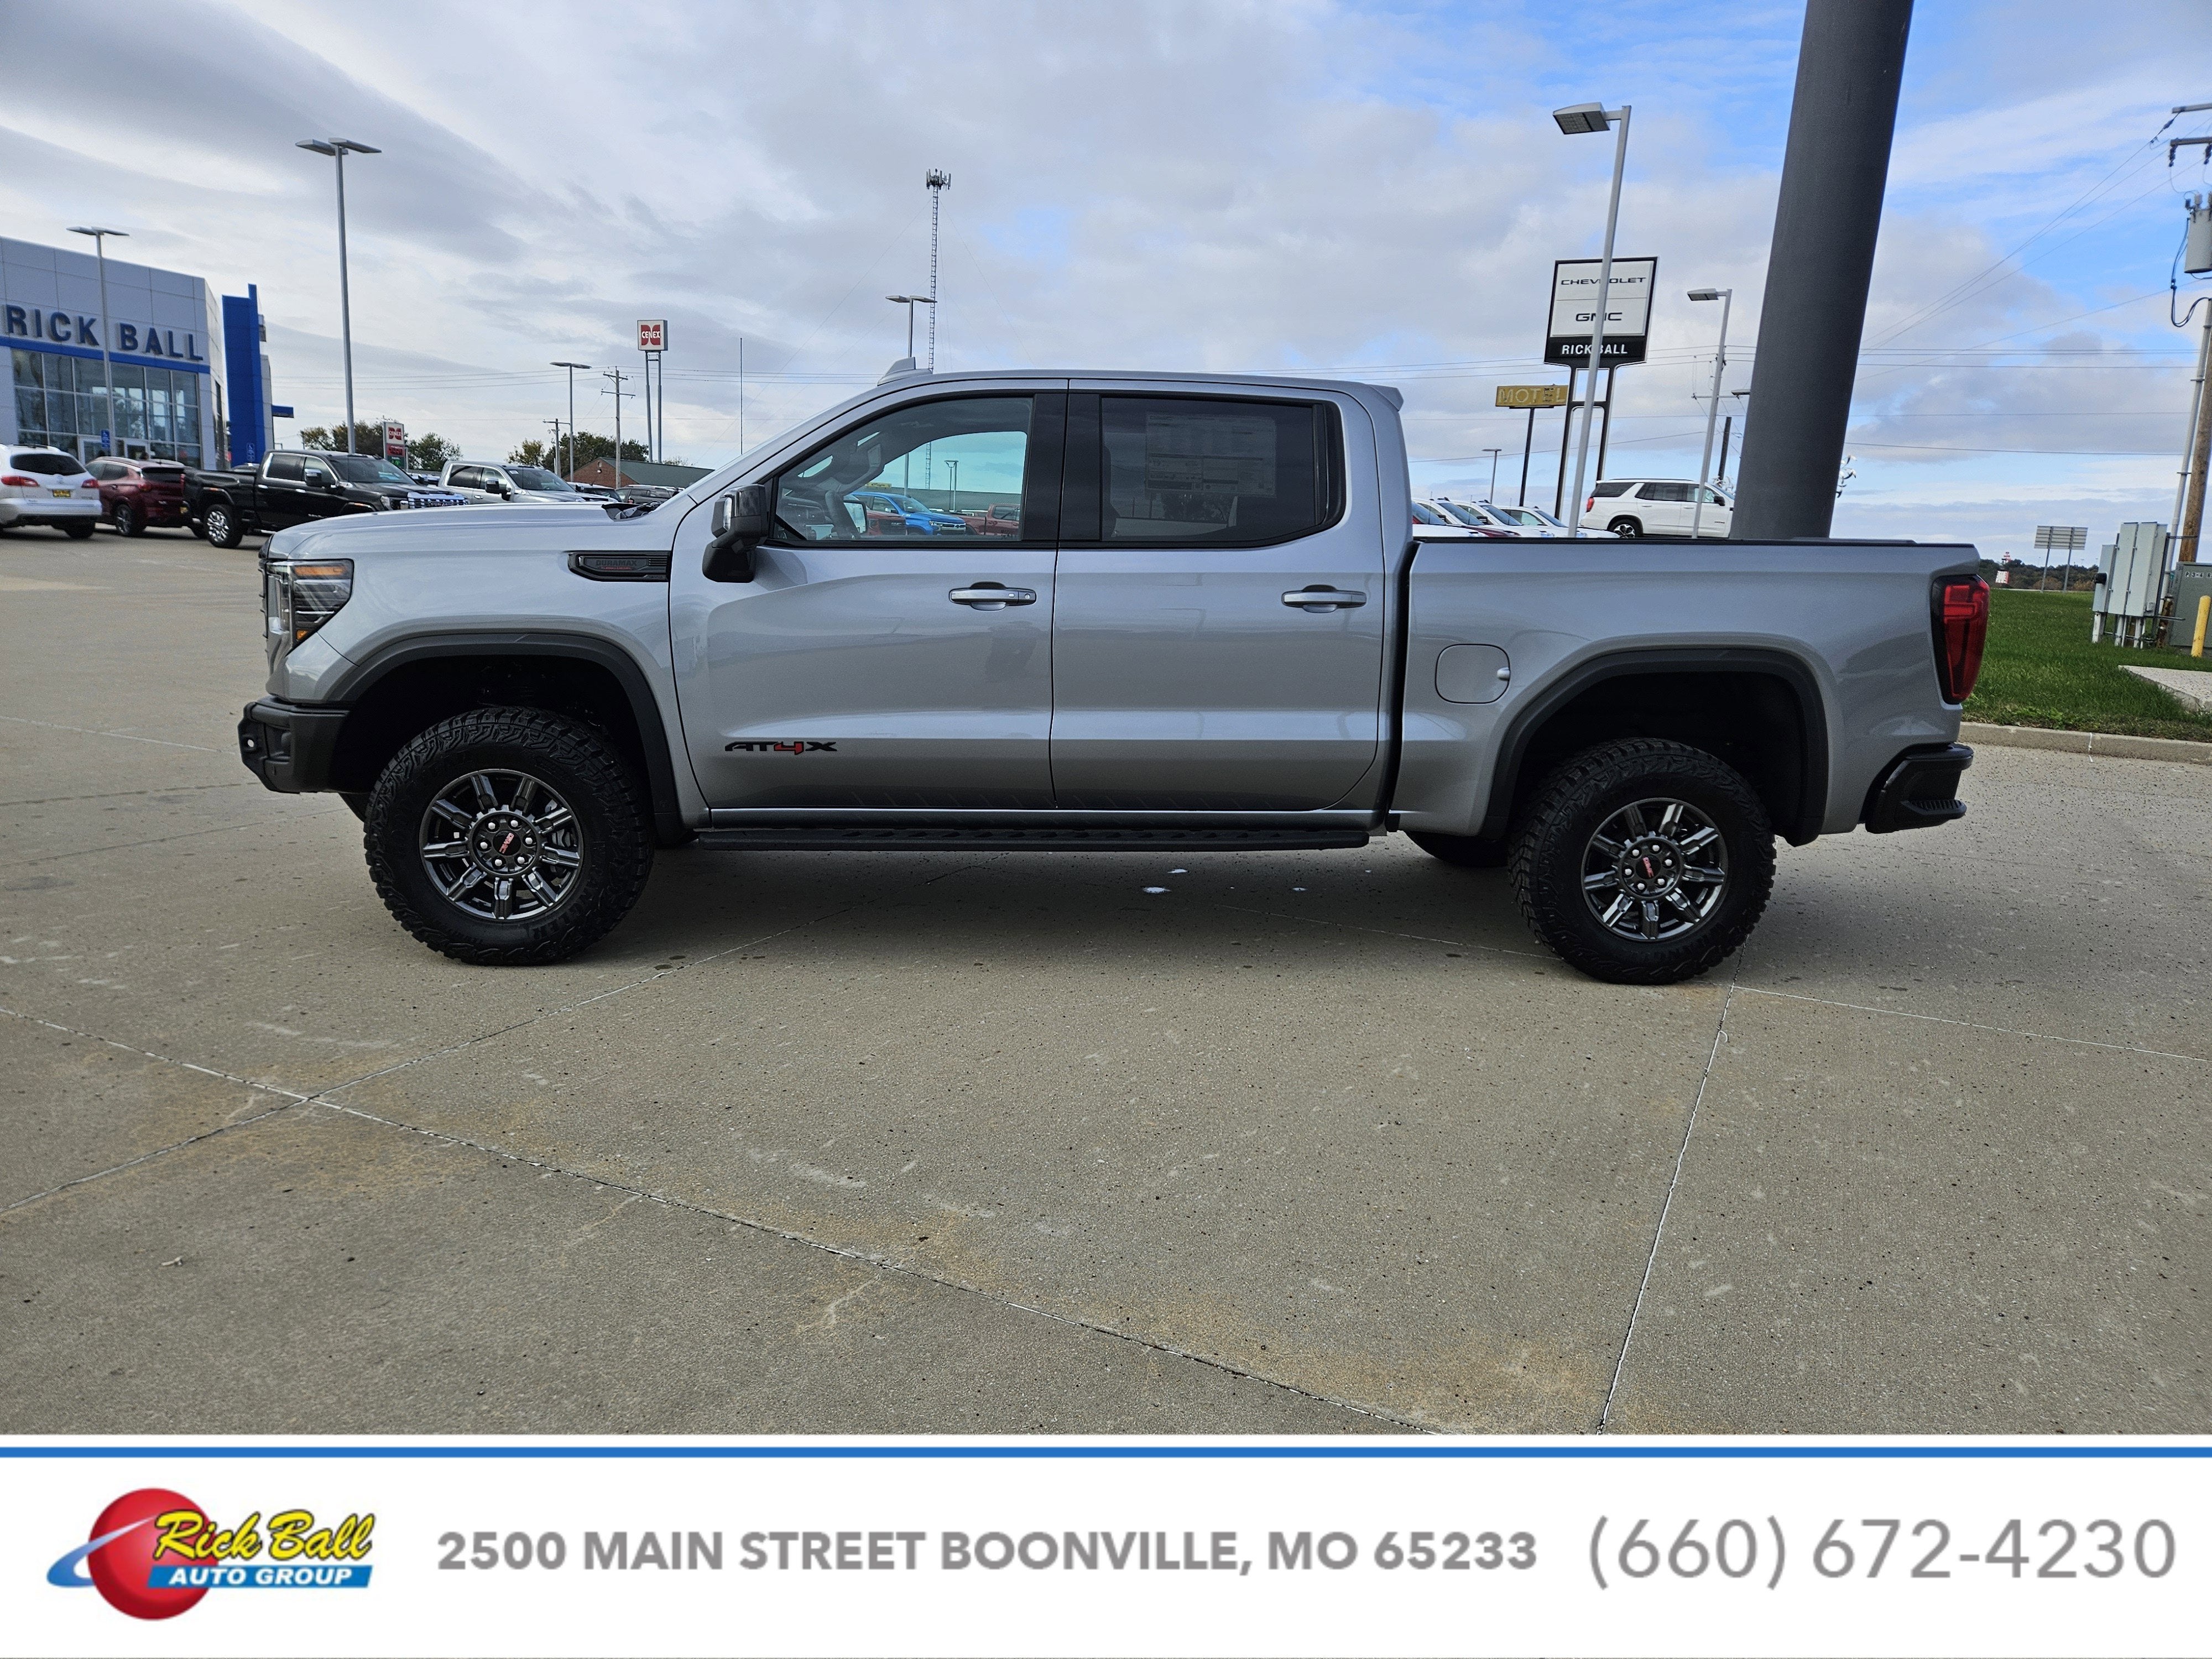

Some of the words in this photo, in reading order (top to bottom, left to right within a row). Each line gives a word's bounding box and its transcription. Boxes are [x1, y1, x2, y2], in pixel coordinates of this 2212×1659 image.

[1561, 277, 1646, 285] CHEVOLET
[6, 304, 100, 346] RICK
[117, 322, 204, 361] BALL
[641, 331, 661, 339] CENEX
[1562, 344, 1593, 355] RICK
[1498, 387, 1566, 404] MOTEL
[725, 741, 837, 755] AT4X
[499, 832, 514, 854] GMC
[1642, 857, 1654, 878] GMC
